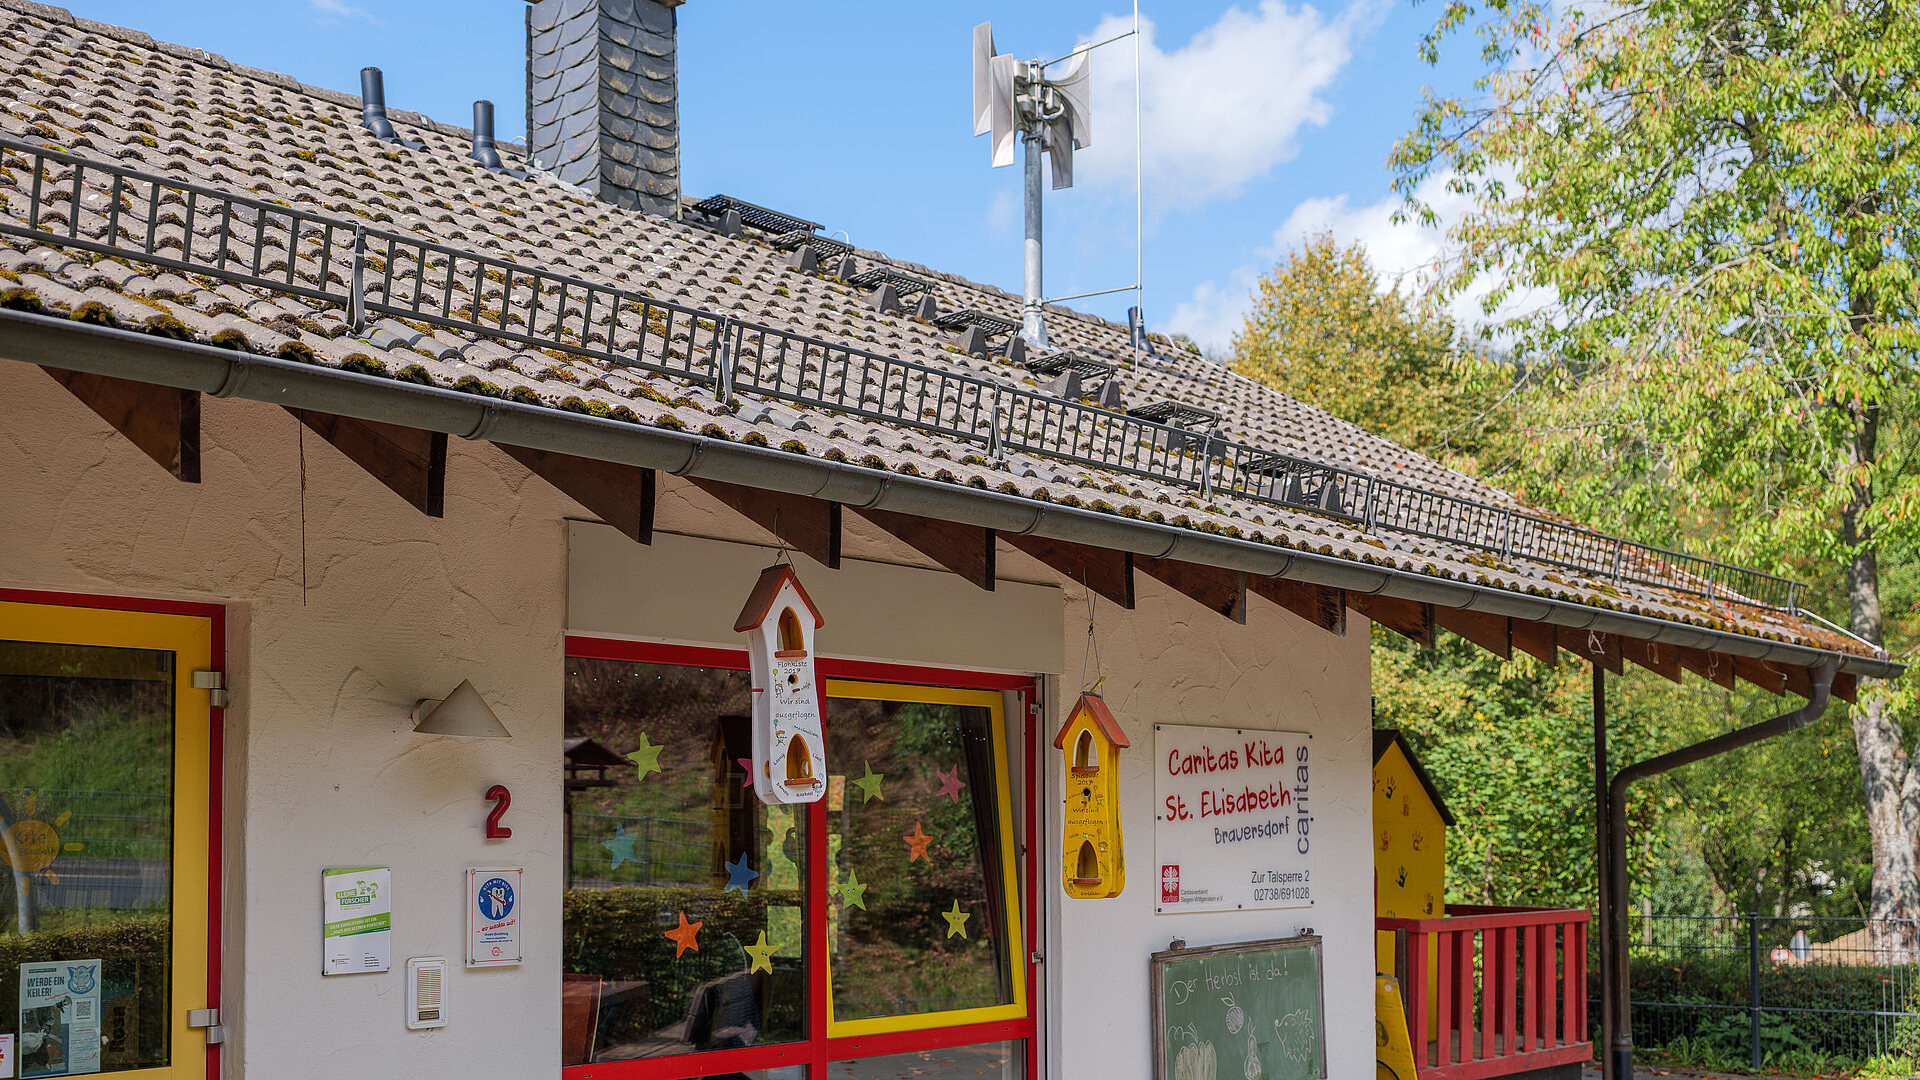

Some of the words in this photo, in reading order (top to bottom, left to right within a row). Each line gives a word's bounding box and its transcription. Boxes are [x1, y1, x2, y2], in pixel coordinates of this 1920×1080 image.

[779, 698, 794, 706] Wir
[775, 710, 816, 721] ausgeflogen
[1168, 745, 1239, 776] Caritas
[1245, 740, 1284, 769] Kita
[1165, 794, 1194, 822] St.
[1201, 780, 1291, 819] Elisabeth
[1293, 745, 1309, 855] caritas
[484, 784, 512, 839] 2
[14, 831, 48, 845] Kita
[1214, 816, 1290, 845] Brauersdorf
[1251, 871, 1267, 884] Zur
[1267, 870, 1303, 887] Talsperre
[1304, 870, 1310, 882] 2
[337, 889, 356, 898] KLEINE
[341, 896, 369, 905] FORSCHER
[1253, 886, 1310, 902] 02738/691028
[27, 977, 52, 987] WERDE
[54, 976, 65, 985] EIN
[1169, 978, 1198, 1005] Der
[1204, 964, 1243, 991] Herbst
[1248, 963, 1261, 981] ist
[27, 987, 52, 998] KEILER!
